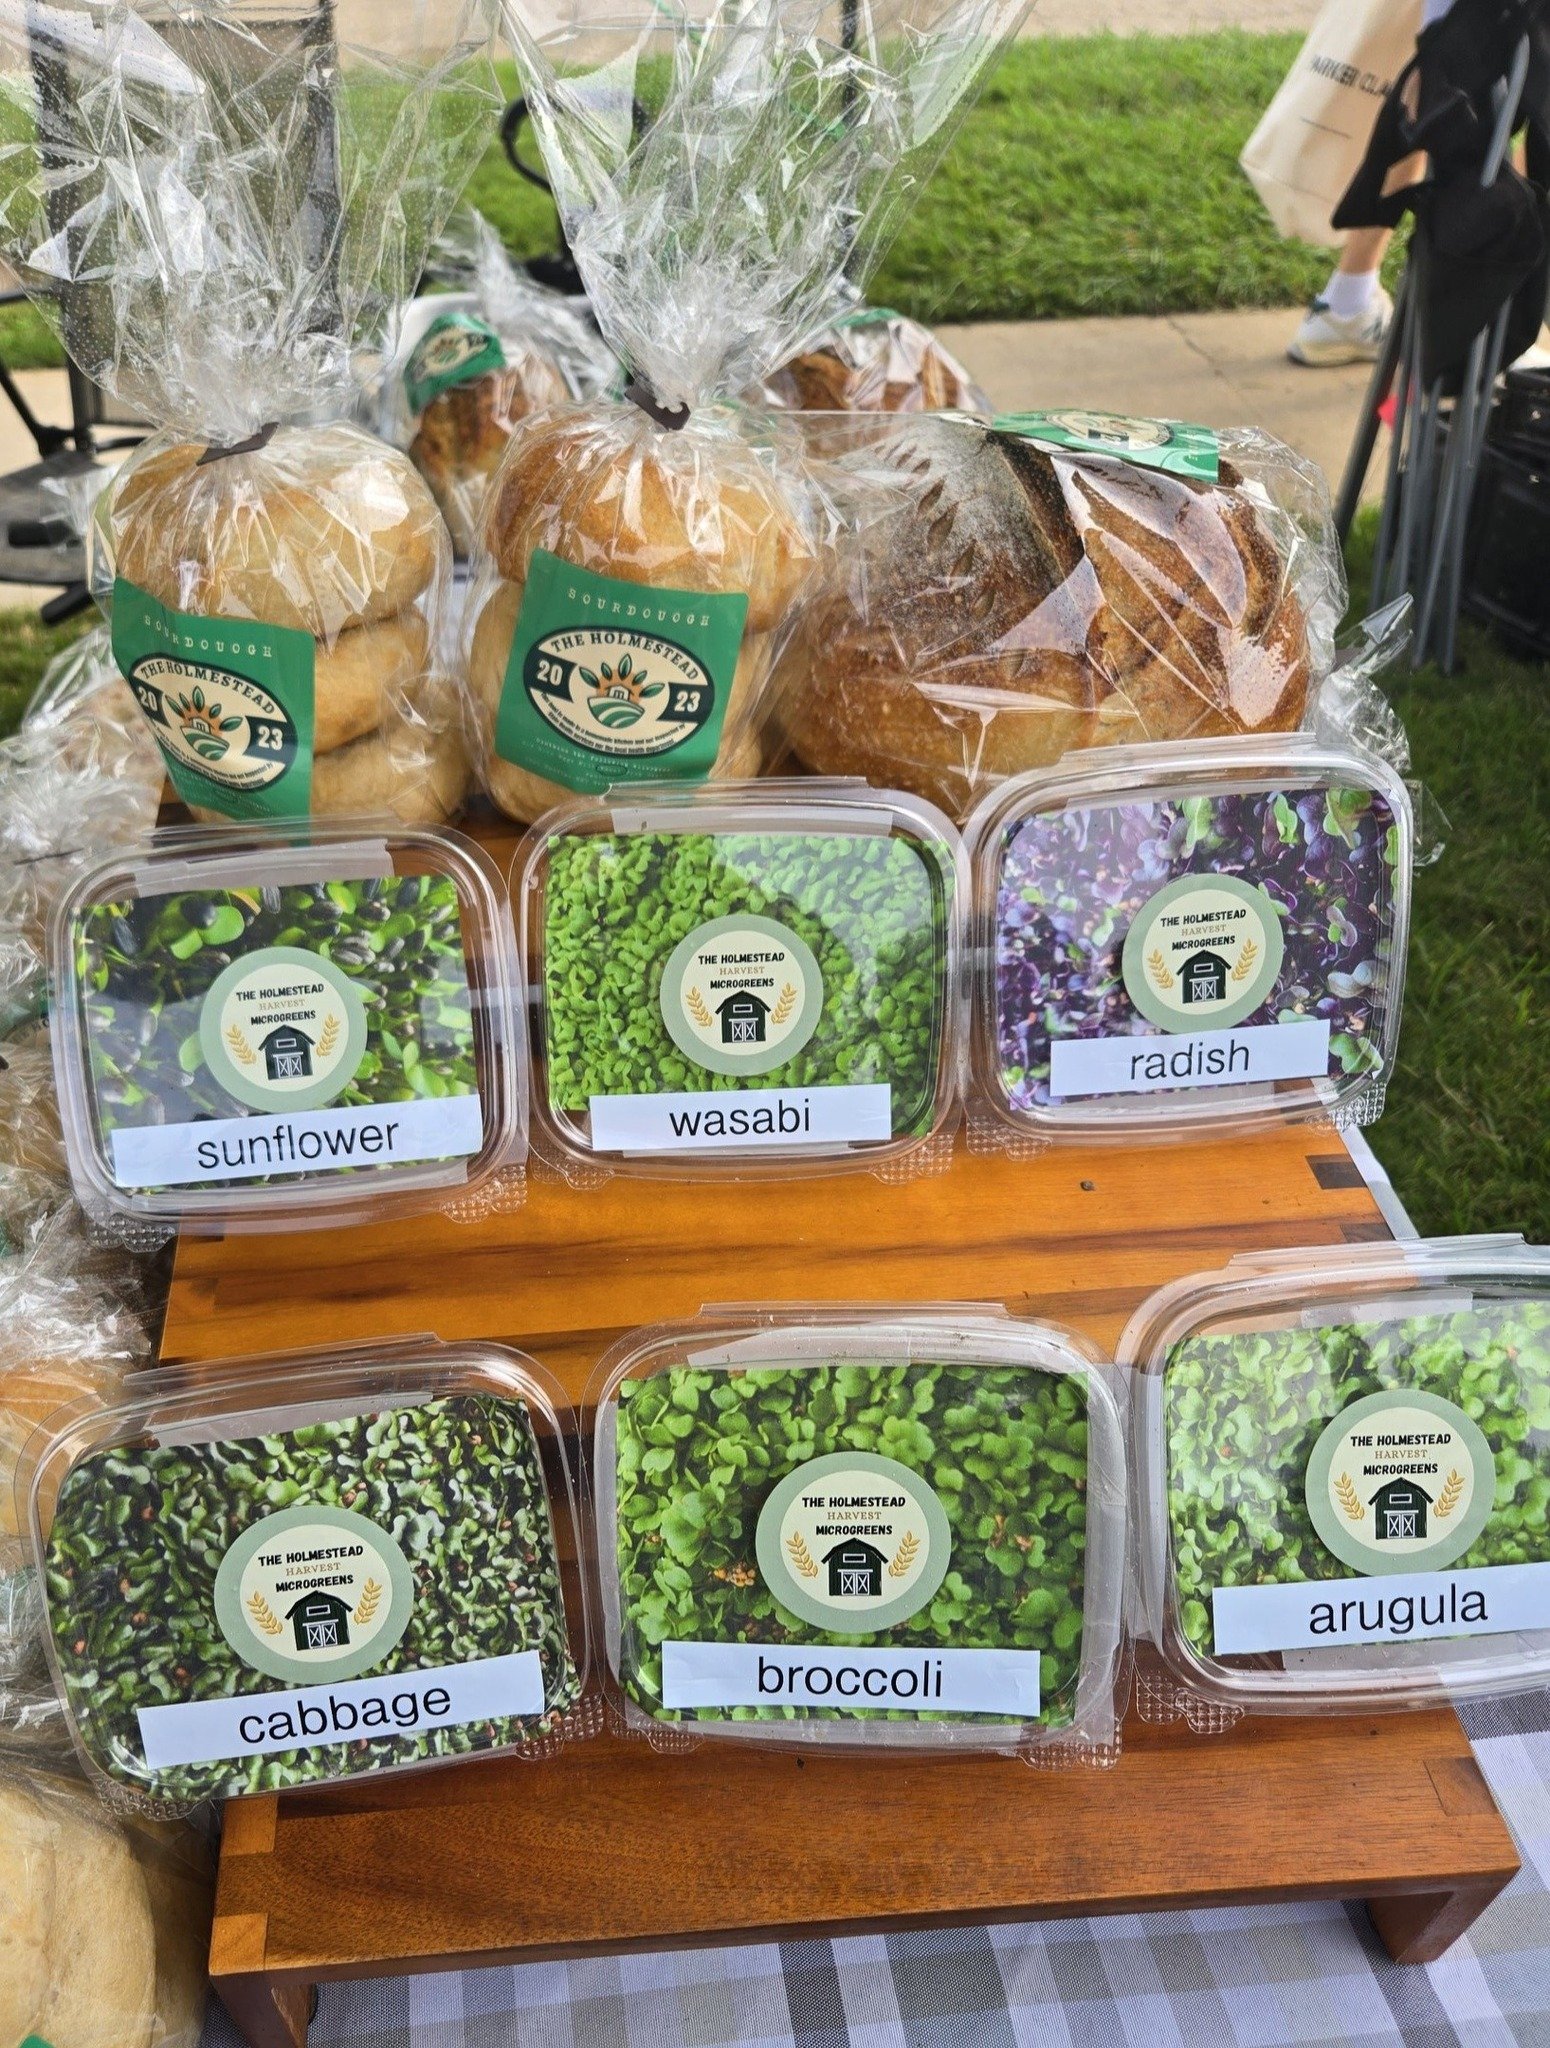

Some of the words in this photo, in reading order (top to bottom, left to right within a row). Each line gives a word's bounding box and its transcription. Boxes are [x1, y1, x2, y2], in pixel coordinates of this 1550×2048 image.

[568, 588, 710, 626] SOURDOUOGH
[550, 633, 586, 653] THE
[589, 632, 700, 681] HOLMESTEAD
[140, 660, 165, 680] THE
[166, 660, 276, 715] HOLMESTEAD
[535, 659, 564, 687] 20
[673, 690, 702, 714] 23
[136, 685, 158, 712] 20
[257, 725, 284, 751] 23
[1161, 916, 1180, 928] THE
[1183, 908, 1246, 925] HOLMESTEAD
[1181, 924, 1227, 936] HARVEST
[1171, 935, 1236, 951] MICROGREENS
[698, 954, 719, 965] THE
[721, 952, 785, 964] HOLMESTEAD
[719, 966, 765, 976] HARVEST
[236, 989, 257, 1002] THE
[259, 983, 325, 999] HOLMESTEAD
[710, 978, 775, 989] MICROGREENS
[258, 999, 306, 1011] HARVEST
[250, 1010, 316, 1026] MICROGREENS
[1130, 1039, 1250, 1081] radish
[669, 1098, 811, 1138] wasabi
[197, 1116, 402, 1171] sunflower
[1350, 1436, 1373, 1447] THE
[1376, 1434, 1452, 1446] HOLMESTEAD
[1375, 1449, 1429, 1460] HARVEST
[1363, 1463, 1439, 1476] MICROGREENS
[802, 1497, 825, 1508] THE
[829, 1497, 906, 1508] HOLMESTEAD
[827, 1511, 882, 1521] HARVEST
[815, 1525, 893, 1536] MICROGREENS
[258, 1554, 282, 1567] THE
[286, 1544, 364, 1563] HOLMESTEAD
[285, 1562, 342, 1577] HARVEST
[275, 1575, 354, 1593] MICROGREENS
[1308, 1583, 1489, 1636] arugula
[757, 1656, 943, 1698] broccoli
[238, 1684, 453, 1746] cabbage
